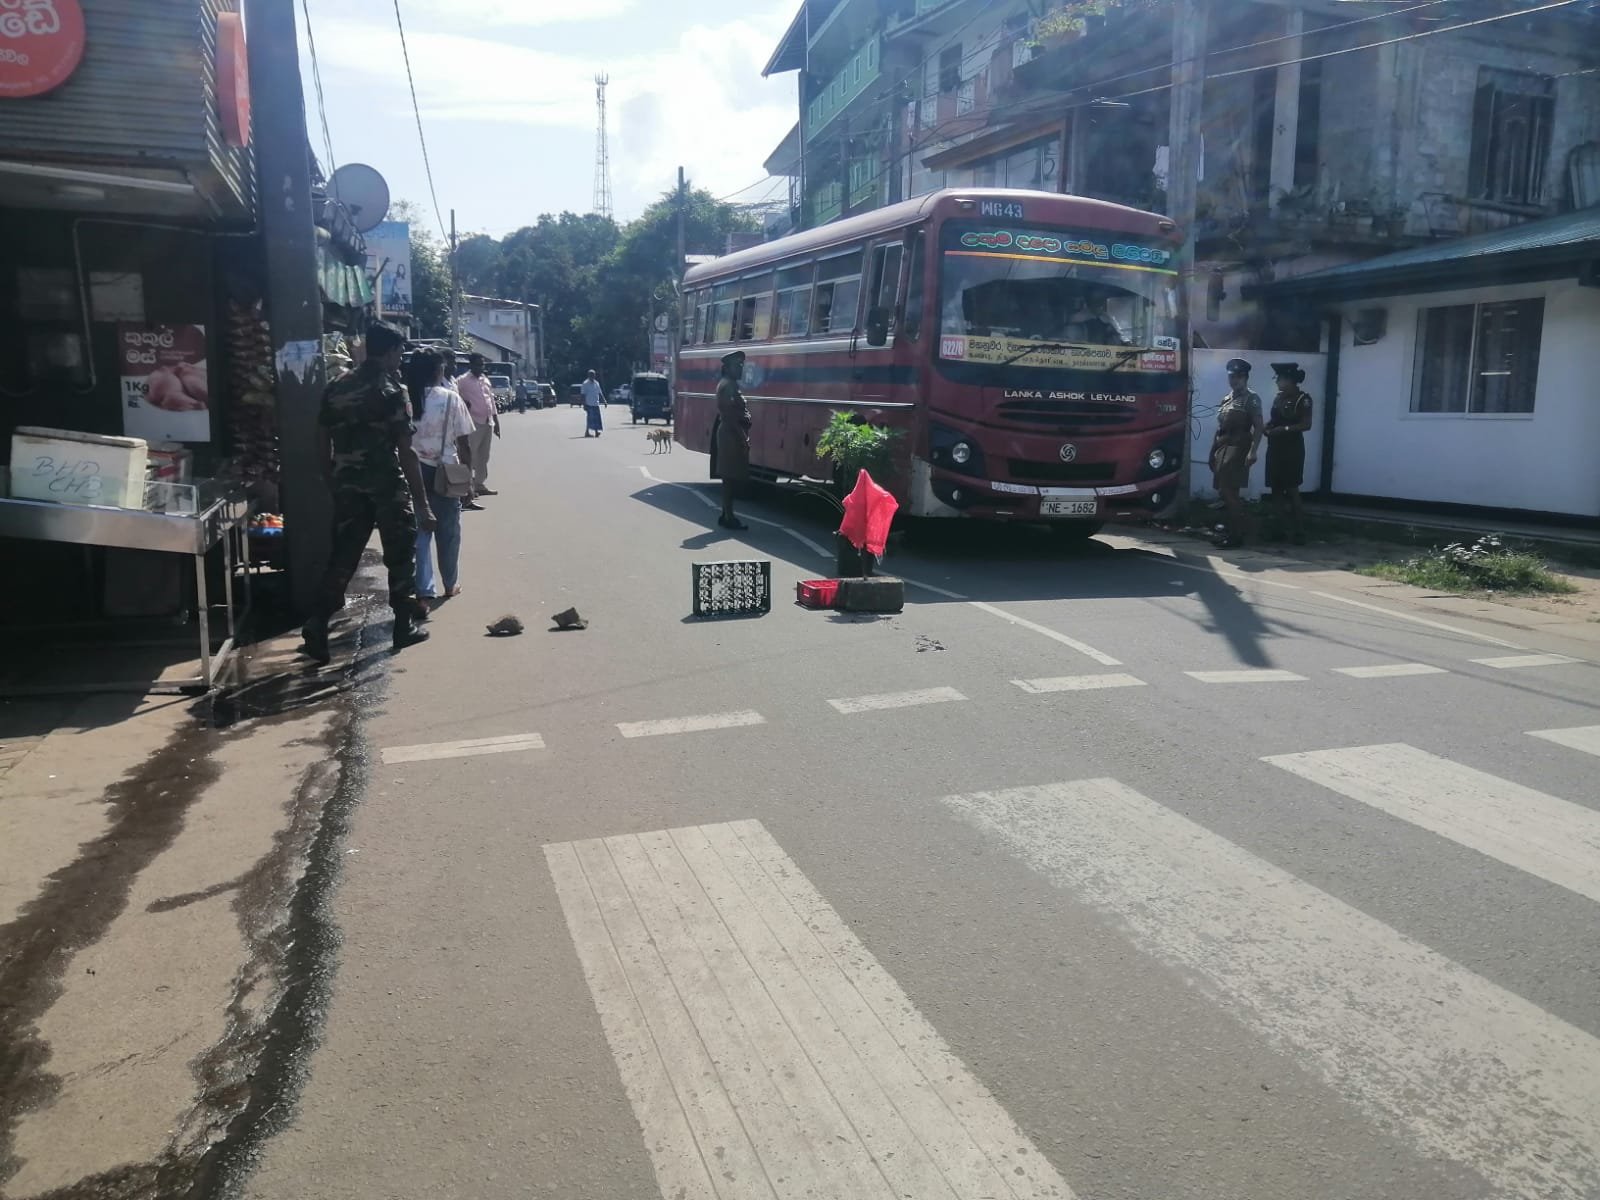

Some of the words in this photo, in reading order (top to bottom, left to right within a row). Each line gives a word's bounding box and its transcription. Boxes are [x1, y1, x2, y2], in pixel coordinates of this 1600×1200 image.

[124, 329, 175, 348] කුකුල්
[126, 349, 157, 364] මස්
[125, 381, 150, 394] 1Kg
[1004, 390, 1042, 398] LANKA
[1049, 391, 1085, 400] ASHOK
[1091, 393, 1136, 402] LEYLAND
